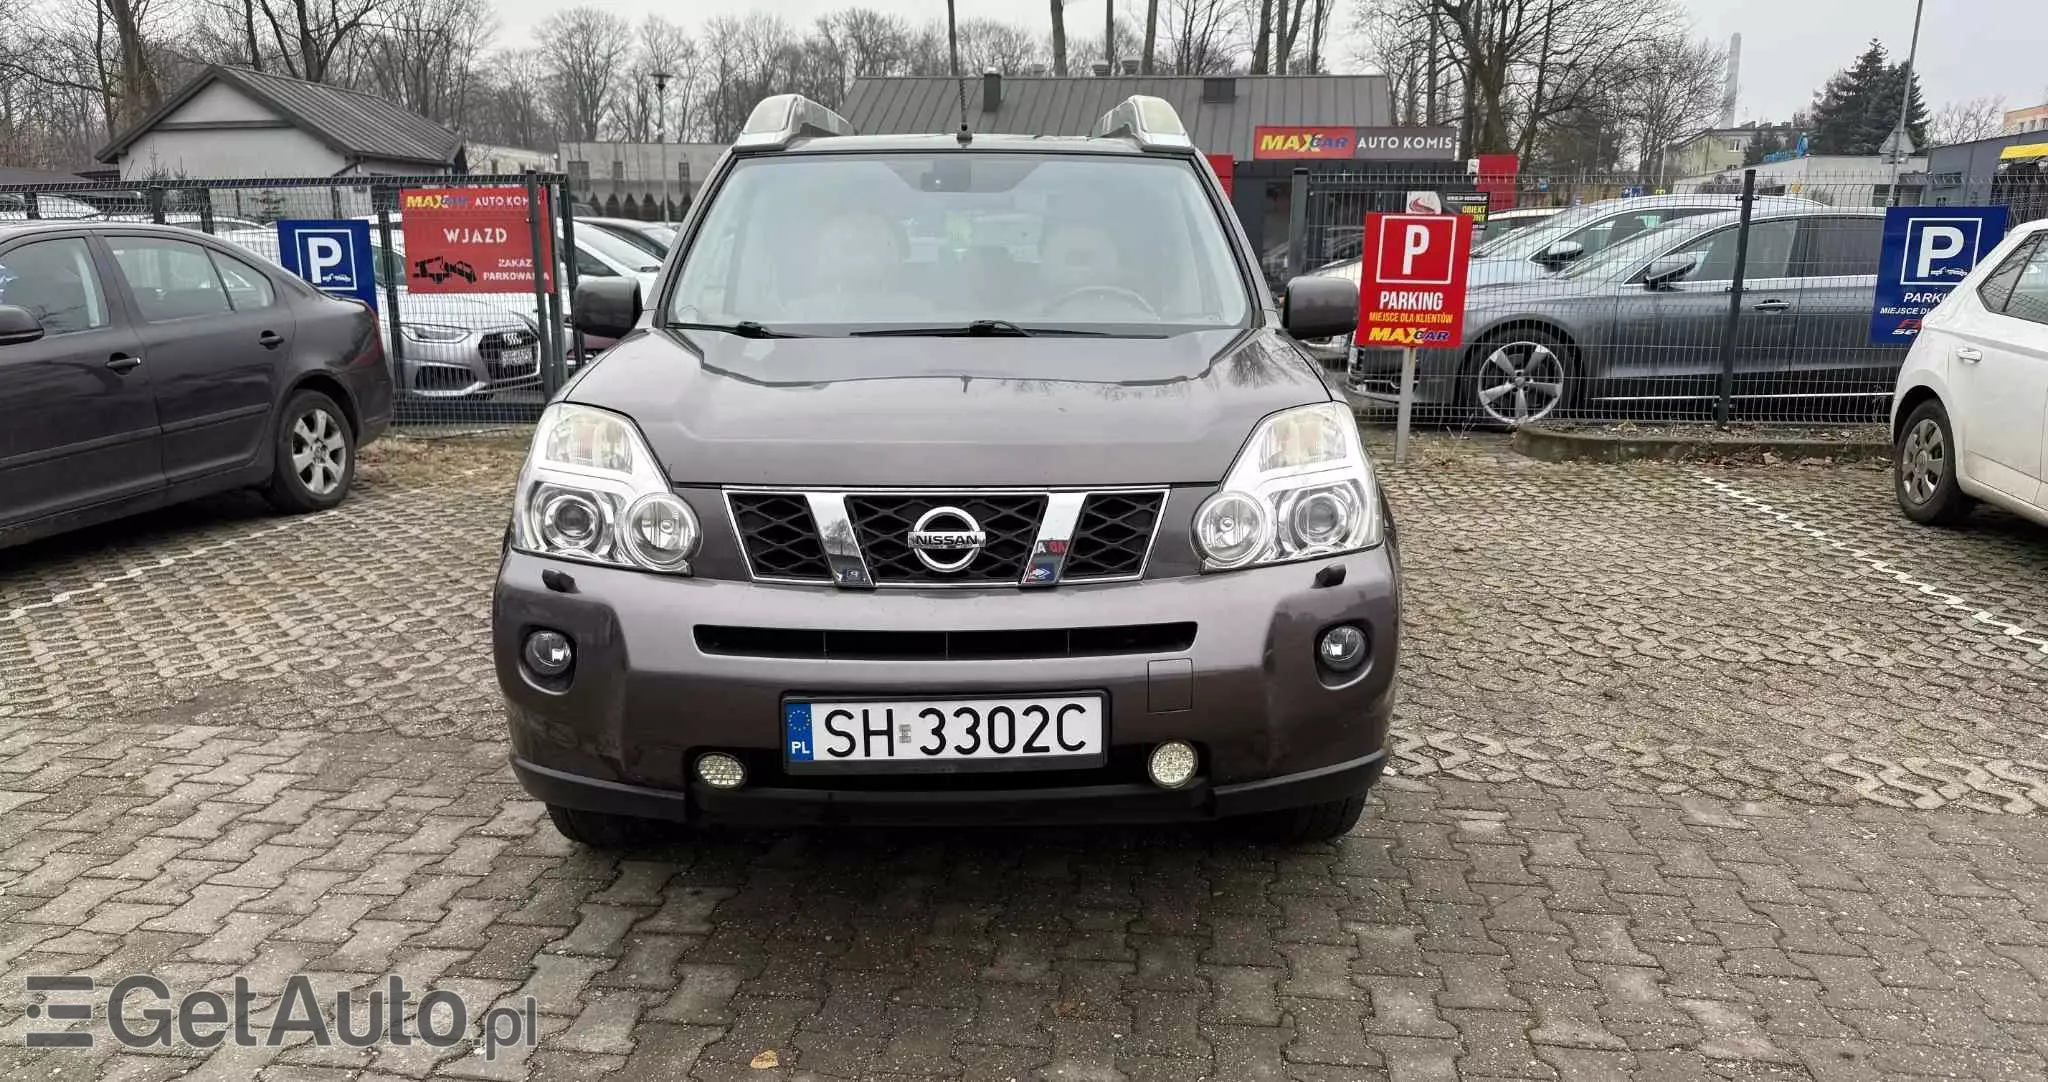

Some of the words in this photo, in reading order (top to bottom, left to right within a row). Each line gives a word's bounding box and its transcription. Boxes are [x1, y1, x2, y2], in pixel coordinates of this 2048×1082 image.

[1358, 136, 1399, 149] AUTO
[1403, 136, 1452, 149] KOMIS
[475, 196, 504, 206] AUTO
[443, 227, 508, 244] WJAZD
[1403, 224, 1430, 275] P
[1917, 226, 1965, 278] P
[308, 237, 342, 284] P
[498, 258, 533, 268] ZAKAZ
[483, 271, 550, 281] PARKOWAA
[1379, 290, 1444, 311] PARKING
[1903, 292, 1948, 303] PARKI
[1369, 311, 1399, 322] MIEJSCE
[1400, 312, 1415, 323] DLA
[1415, 312, 1453, 324] KLIENTÓW
[1880, 307, 1919, 315] MIEJSCE
[1368, 327, 1450, 344] MAXCAR
[914, 534, 979, 546] NISSAN
[824, 707, 895, 757] SH
[917, 703, 1087, 756] 3302C
[791, 741, 810, 754] PL
